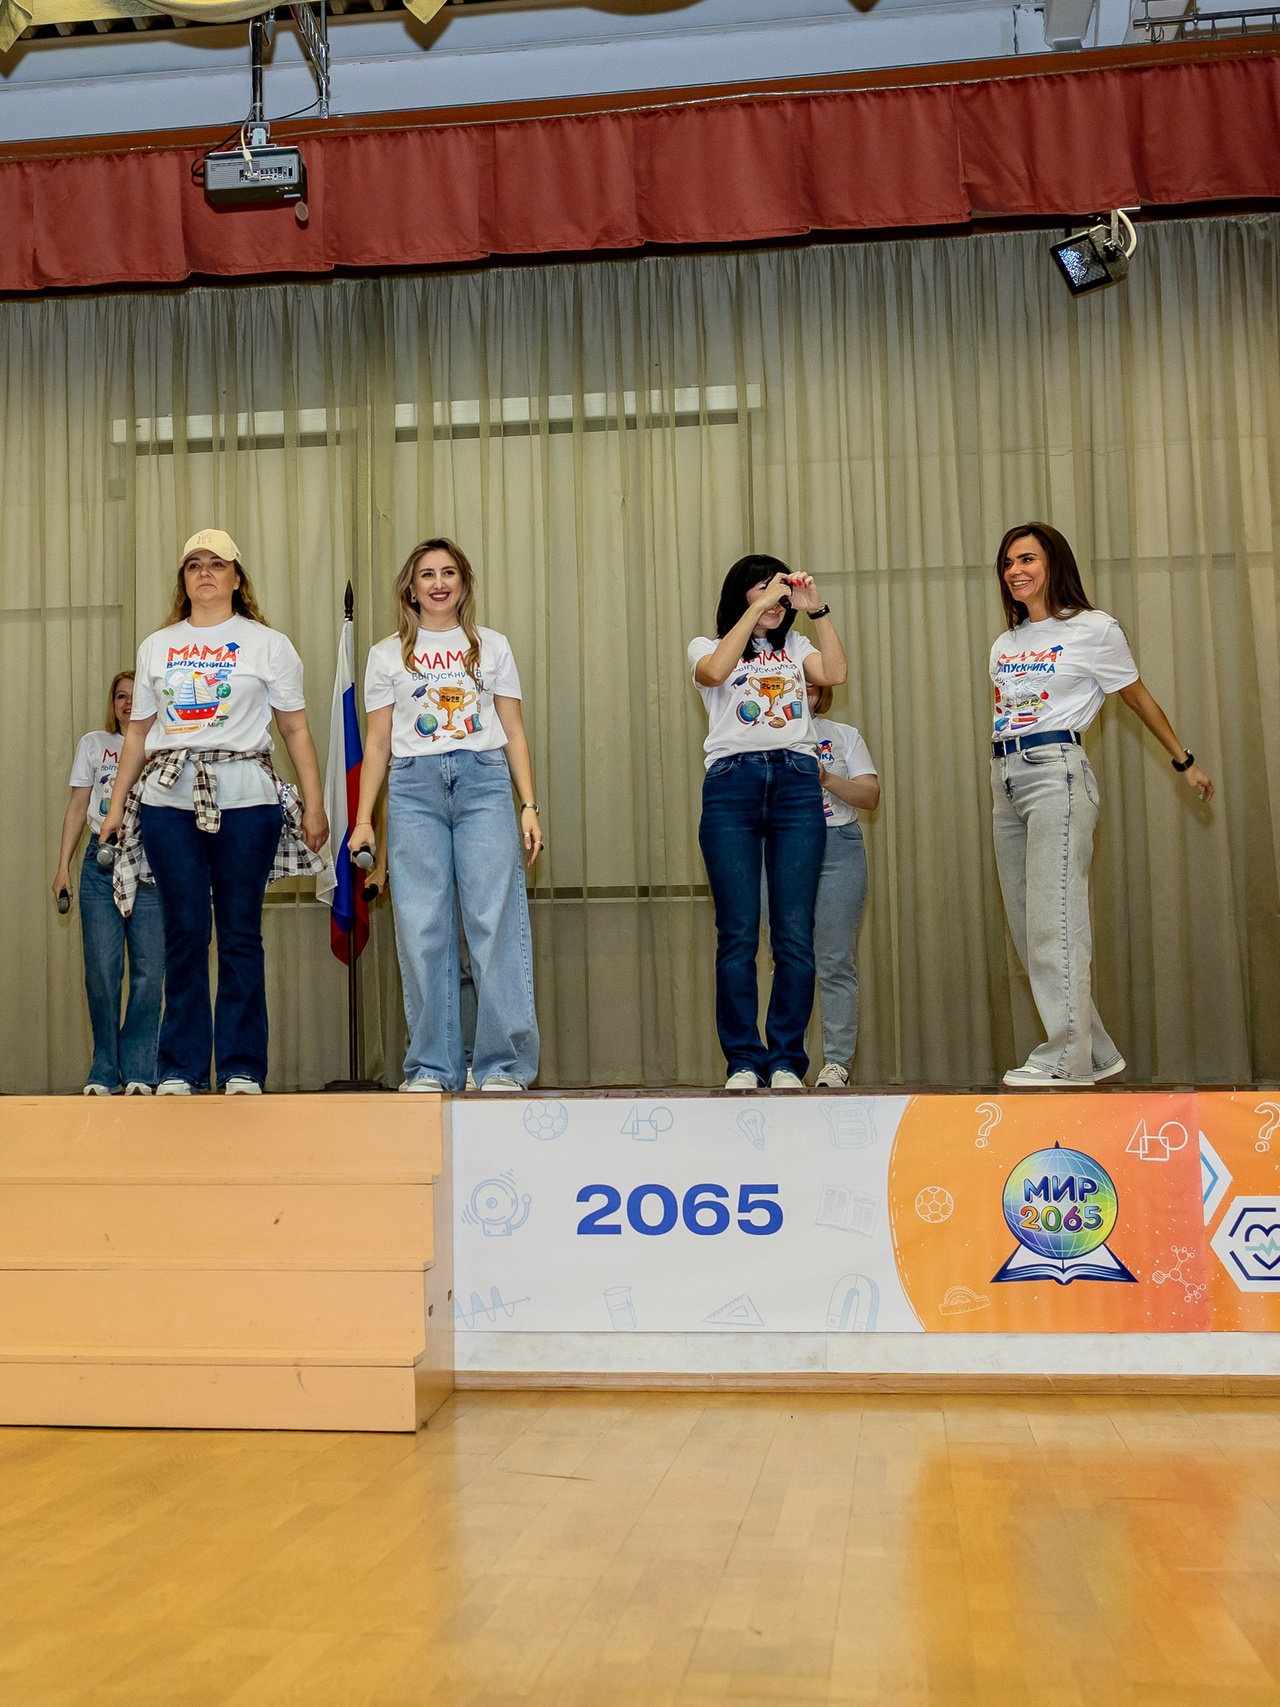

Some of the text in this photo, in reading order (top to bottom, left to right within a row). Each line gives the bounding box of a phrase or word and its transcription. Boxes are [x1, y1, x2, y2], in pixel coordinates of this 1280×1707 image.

[167, 643, 237, 662] МАМА
[412, 650, 481, 669] МАМ
[441, 695, 461, 703] 2025
[1023, 1175, 1099, 1204] МИР
[576, 1183, 784, 1237] 2065
[1020, 1205, 1104, 1233] 2065
